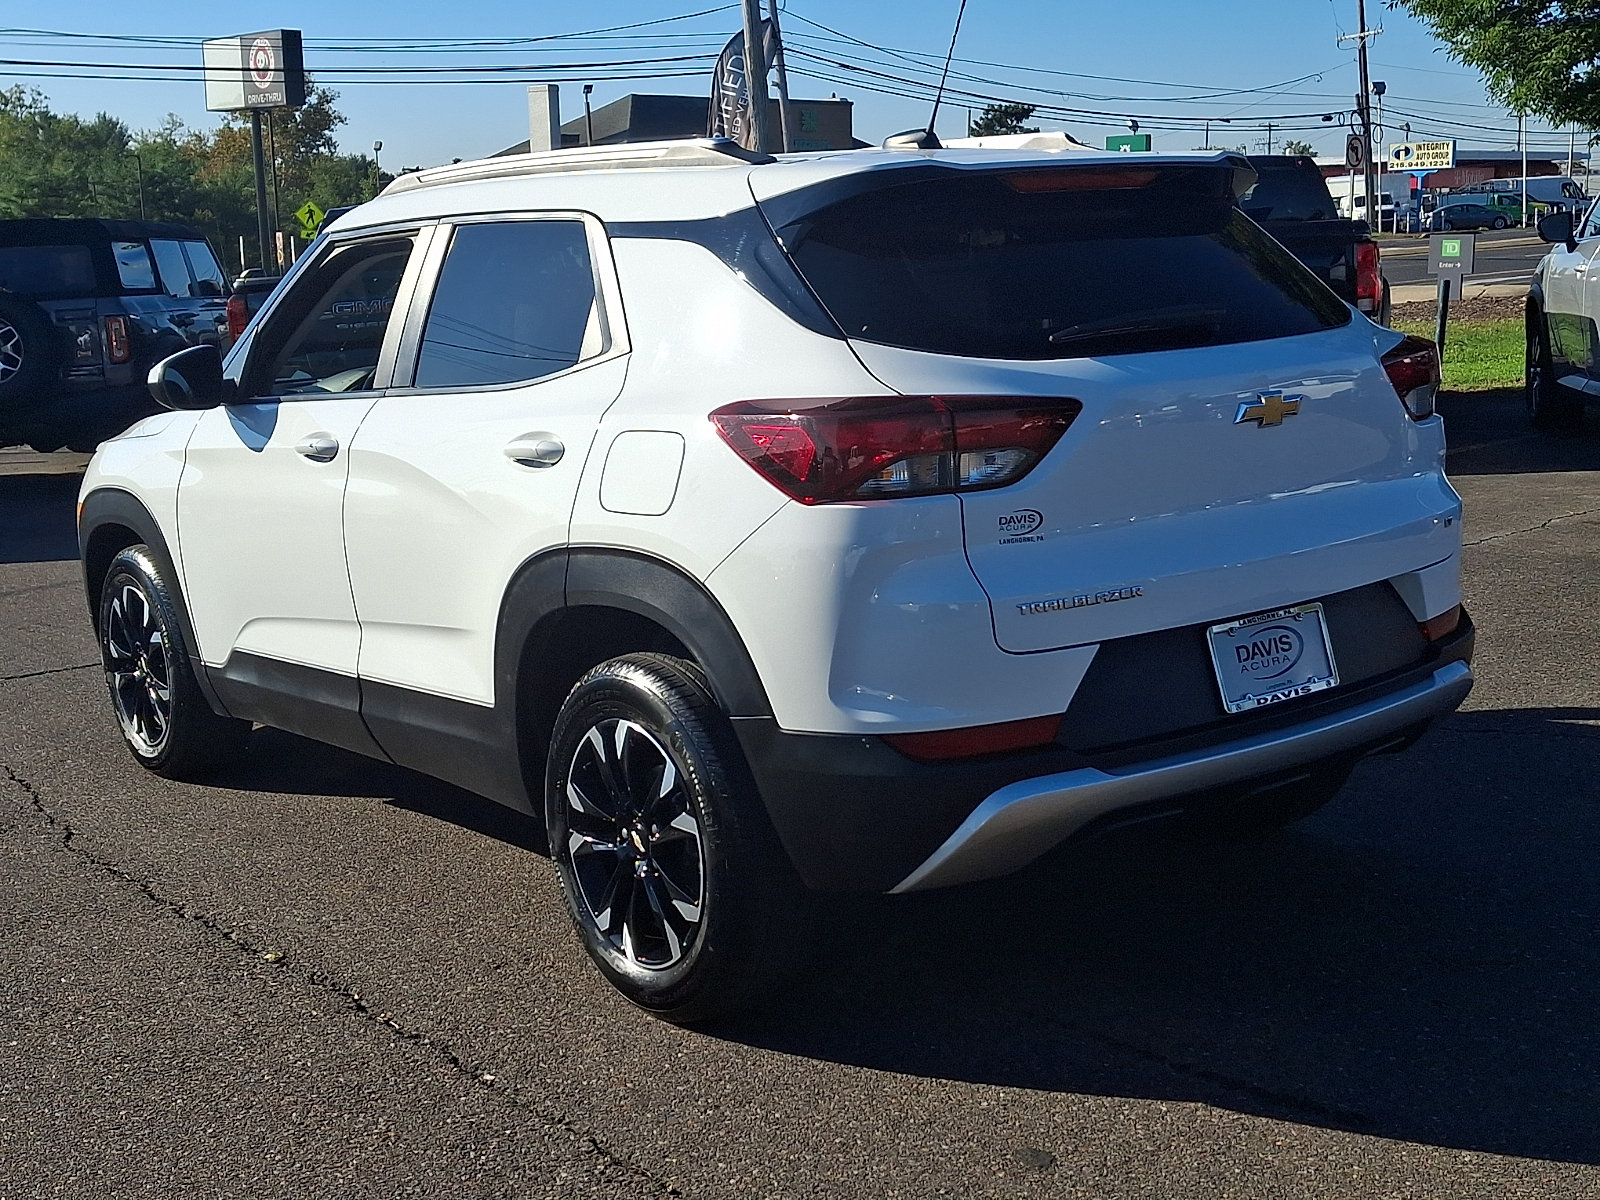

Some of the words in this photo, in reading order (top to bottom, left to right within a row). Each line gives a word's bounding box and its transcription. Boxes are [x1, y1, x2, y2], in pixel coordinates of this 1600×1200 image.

[247, 92, 282, 104] DRIVE-THRU
[1415, 142, 1451, 152] INTEGRITY
[1416, 152, 1430, 161] AUTO
[1431, 150, 1450, 160] GROUP
[1444, 242, 1458, 254] TD
[998, 513, 1036, 526] DAVIS
[998, 523, 1033, 532] ACURA
[998, 536, 1036, 545] LANGHORNE,
[1015, 585, 1144, 616] TRAILBLAZER
[1235, 634, 1293, 664] DAVIS
[1240, 654, 1291, 674] ACURA
[1256, 685, 1312, 706] DAVIS
